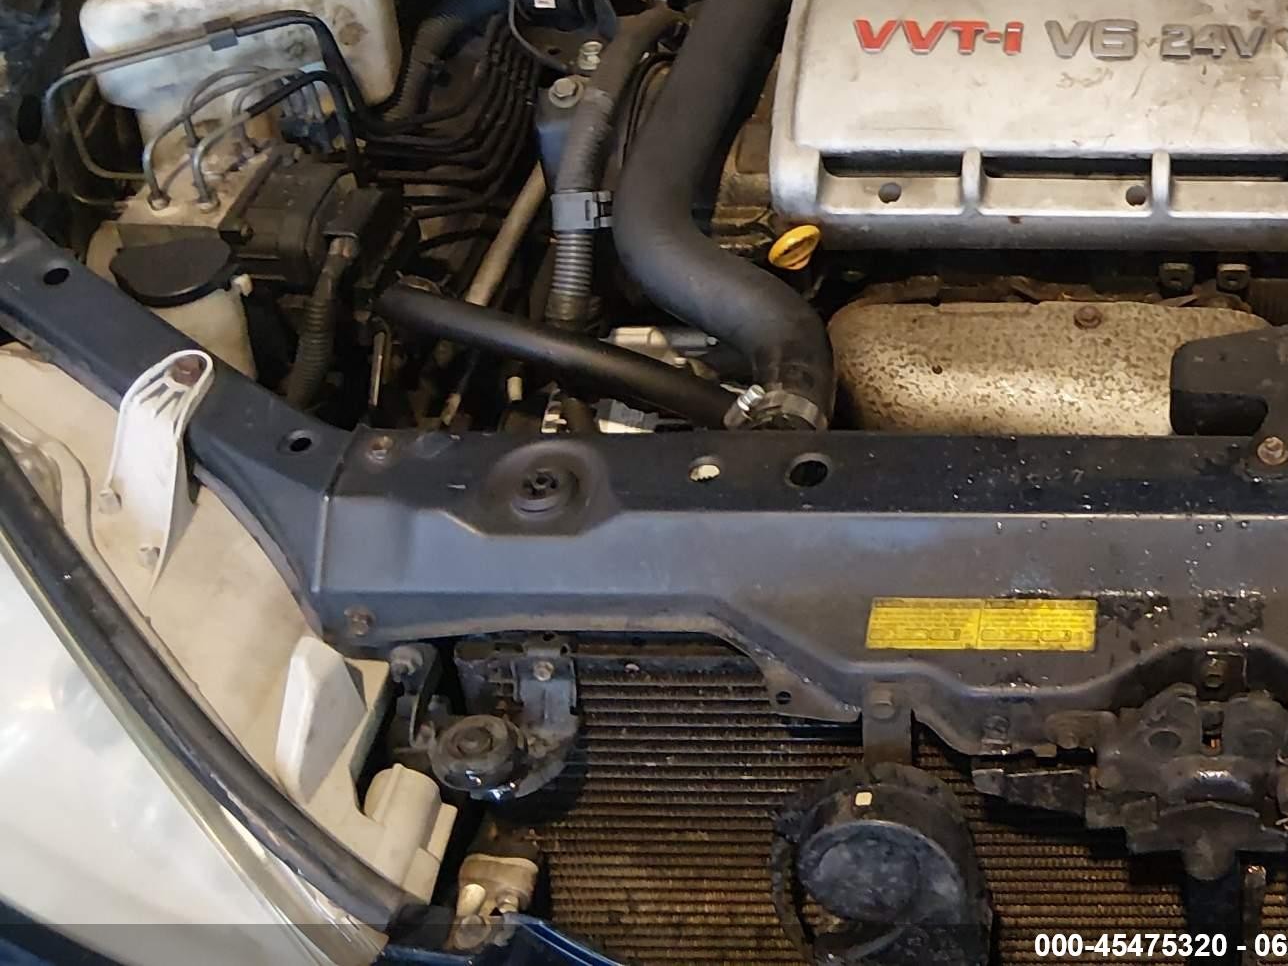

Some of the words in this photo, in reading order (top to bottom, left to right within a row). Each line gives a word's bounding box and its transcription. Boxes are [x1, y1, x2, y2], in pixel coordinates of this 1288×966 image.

[853, 19, 1023, 56] VVT-i
[1044, 19, 1138, 61] V6
[1159, 23, 1267, 61] 24V
